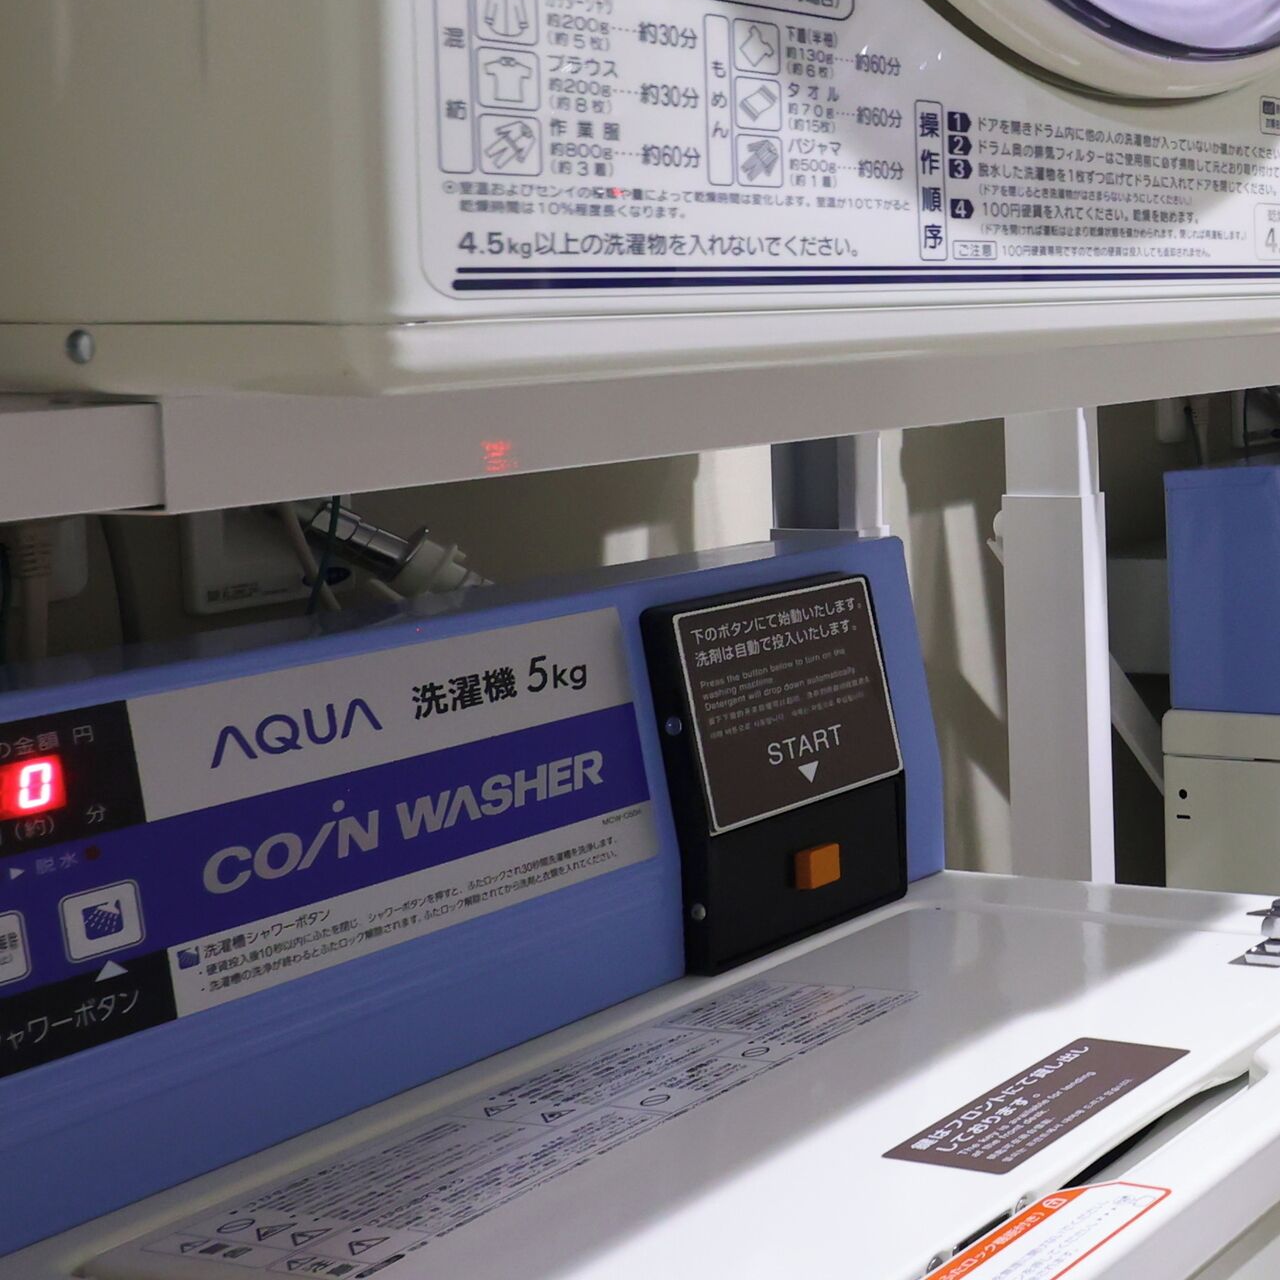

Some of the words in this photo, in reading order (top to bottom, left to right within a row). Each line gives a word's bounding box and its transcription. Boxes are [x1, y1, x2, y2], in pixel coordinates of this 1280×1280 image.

[953, 114, 962, 131] 1
[953, 138, 965, 154] 2
[954, 162, 965, 178] 3
[955, 201, 967, 218] 4
[457, 231, 860, 259] 4.5kg以上の洗濯物を入れないでください。
[690, 597, 862, 646] 下のボタンにて始動いたします。
[694, 619, 857, 668] 洗剤は自動で投入いたします。
[210, 698, 382, 769] AQUA
[412, 665, 518, 720] 洗濯機
[527, 655, 588, 694] 5kg
[72, 724, 94, 746] 円
[767, 724, 842, 766] START
[18, 761, 52, 810] 0
[87, 805, 107, 824] 分
[203, 799, 379, 894] COIN
[396, 750, 603, 840] WASHER
